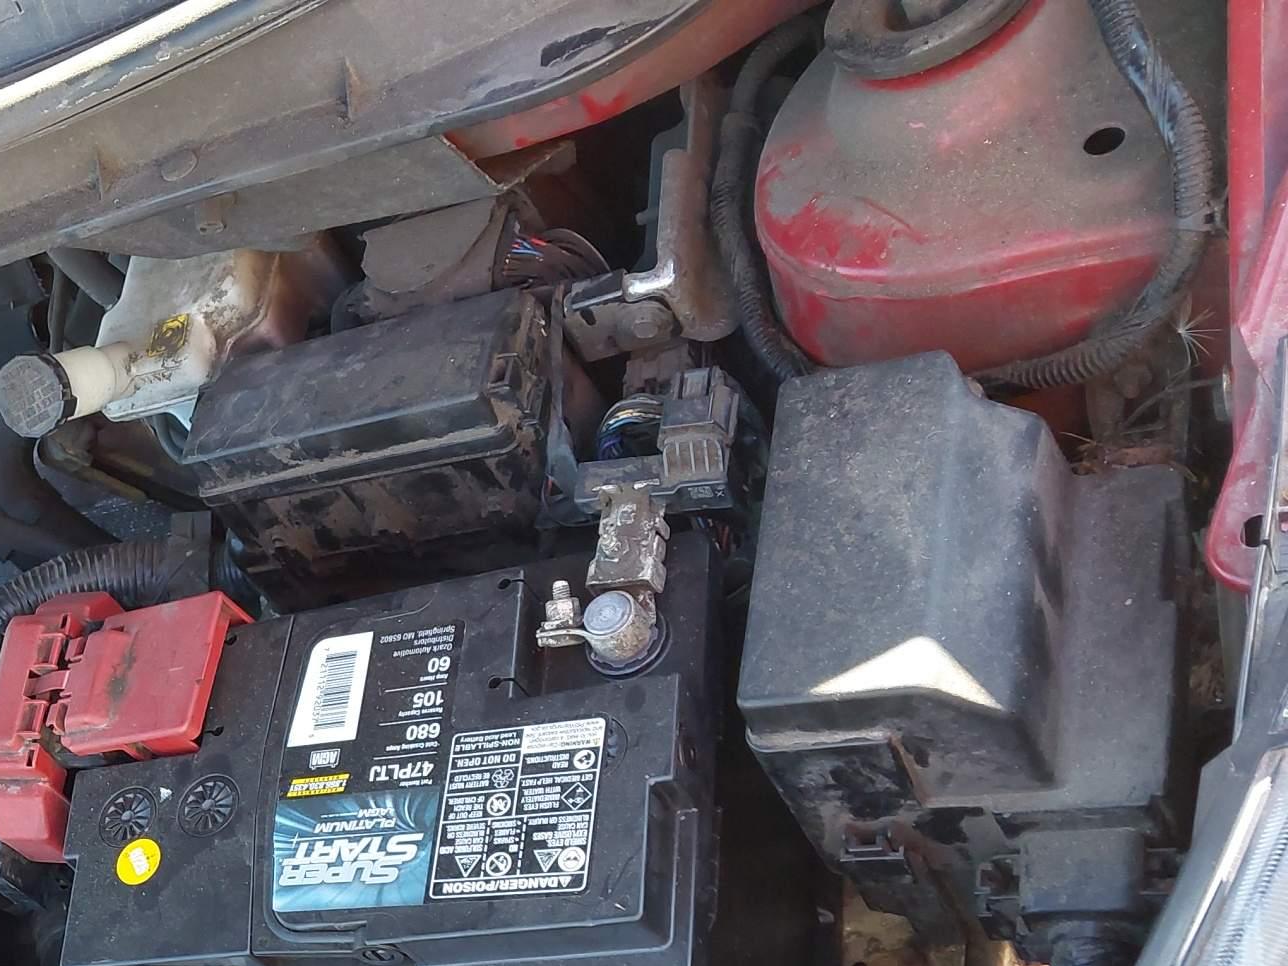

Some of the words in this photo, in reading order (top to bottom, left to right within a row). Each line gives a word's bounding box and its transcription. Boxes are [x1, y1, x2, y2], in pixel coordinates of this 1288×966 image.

[379, 633, 401, 643] 65802
[402, 631, 415, 640] MO
[413, 633, 454, 646] Distributors
[392, 645, 431, 658] Automotive
[432, 642, 452, 652] Ozark
[426, 655, 451, 673] 60
[418, 674, 435, 682] Hours
[411, 688, 445, 708] 105
[397, 708, 420, 717] Capacity
[421, 706, 443, 714] Reserve
[404, 721, 441, 741] 680
[484, 733, 499, 741] Acid
[385, 744, 400, 752] Amps
[400, 741, 424, 750] Cranking
[454, 738, 520, 751] NON-SPILLABLE
[310, 751, 337, 765] AGM
[453, 756, 481, 767] OPEN.
[481, 754, 501, 765] NOT
[502, 753, 516, 763] DO
[368, 759, 434, 781] 47PLTJ
[536, 777, 553, 785] HELP
[553, 774, 580, 783] MEDICAL
[581, 773, 593, 781] GET
[398, 779, 420, 787] Number
[464, 779, 489, 788] BATTERY
[544, 785, 561, 793] WITH
[522, 802, 538, 810] EYES
[539, 801, 559, 809] FLUSH
[312, 817, 396, 833] PLATINUM
[281, 832, 423, 869] START
[277, 858, 401, 888] SUPER
[442, 876, 559, 893] DANGER/POISON
